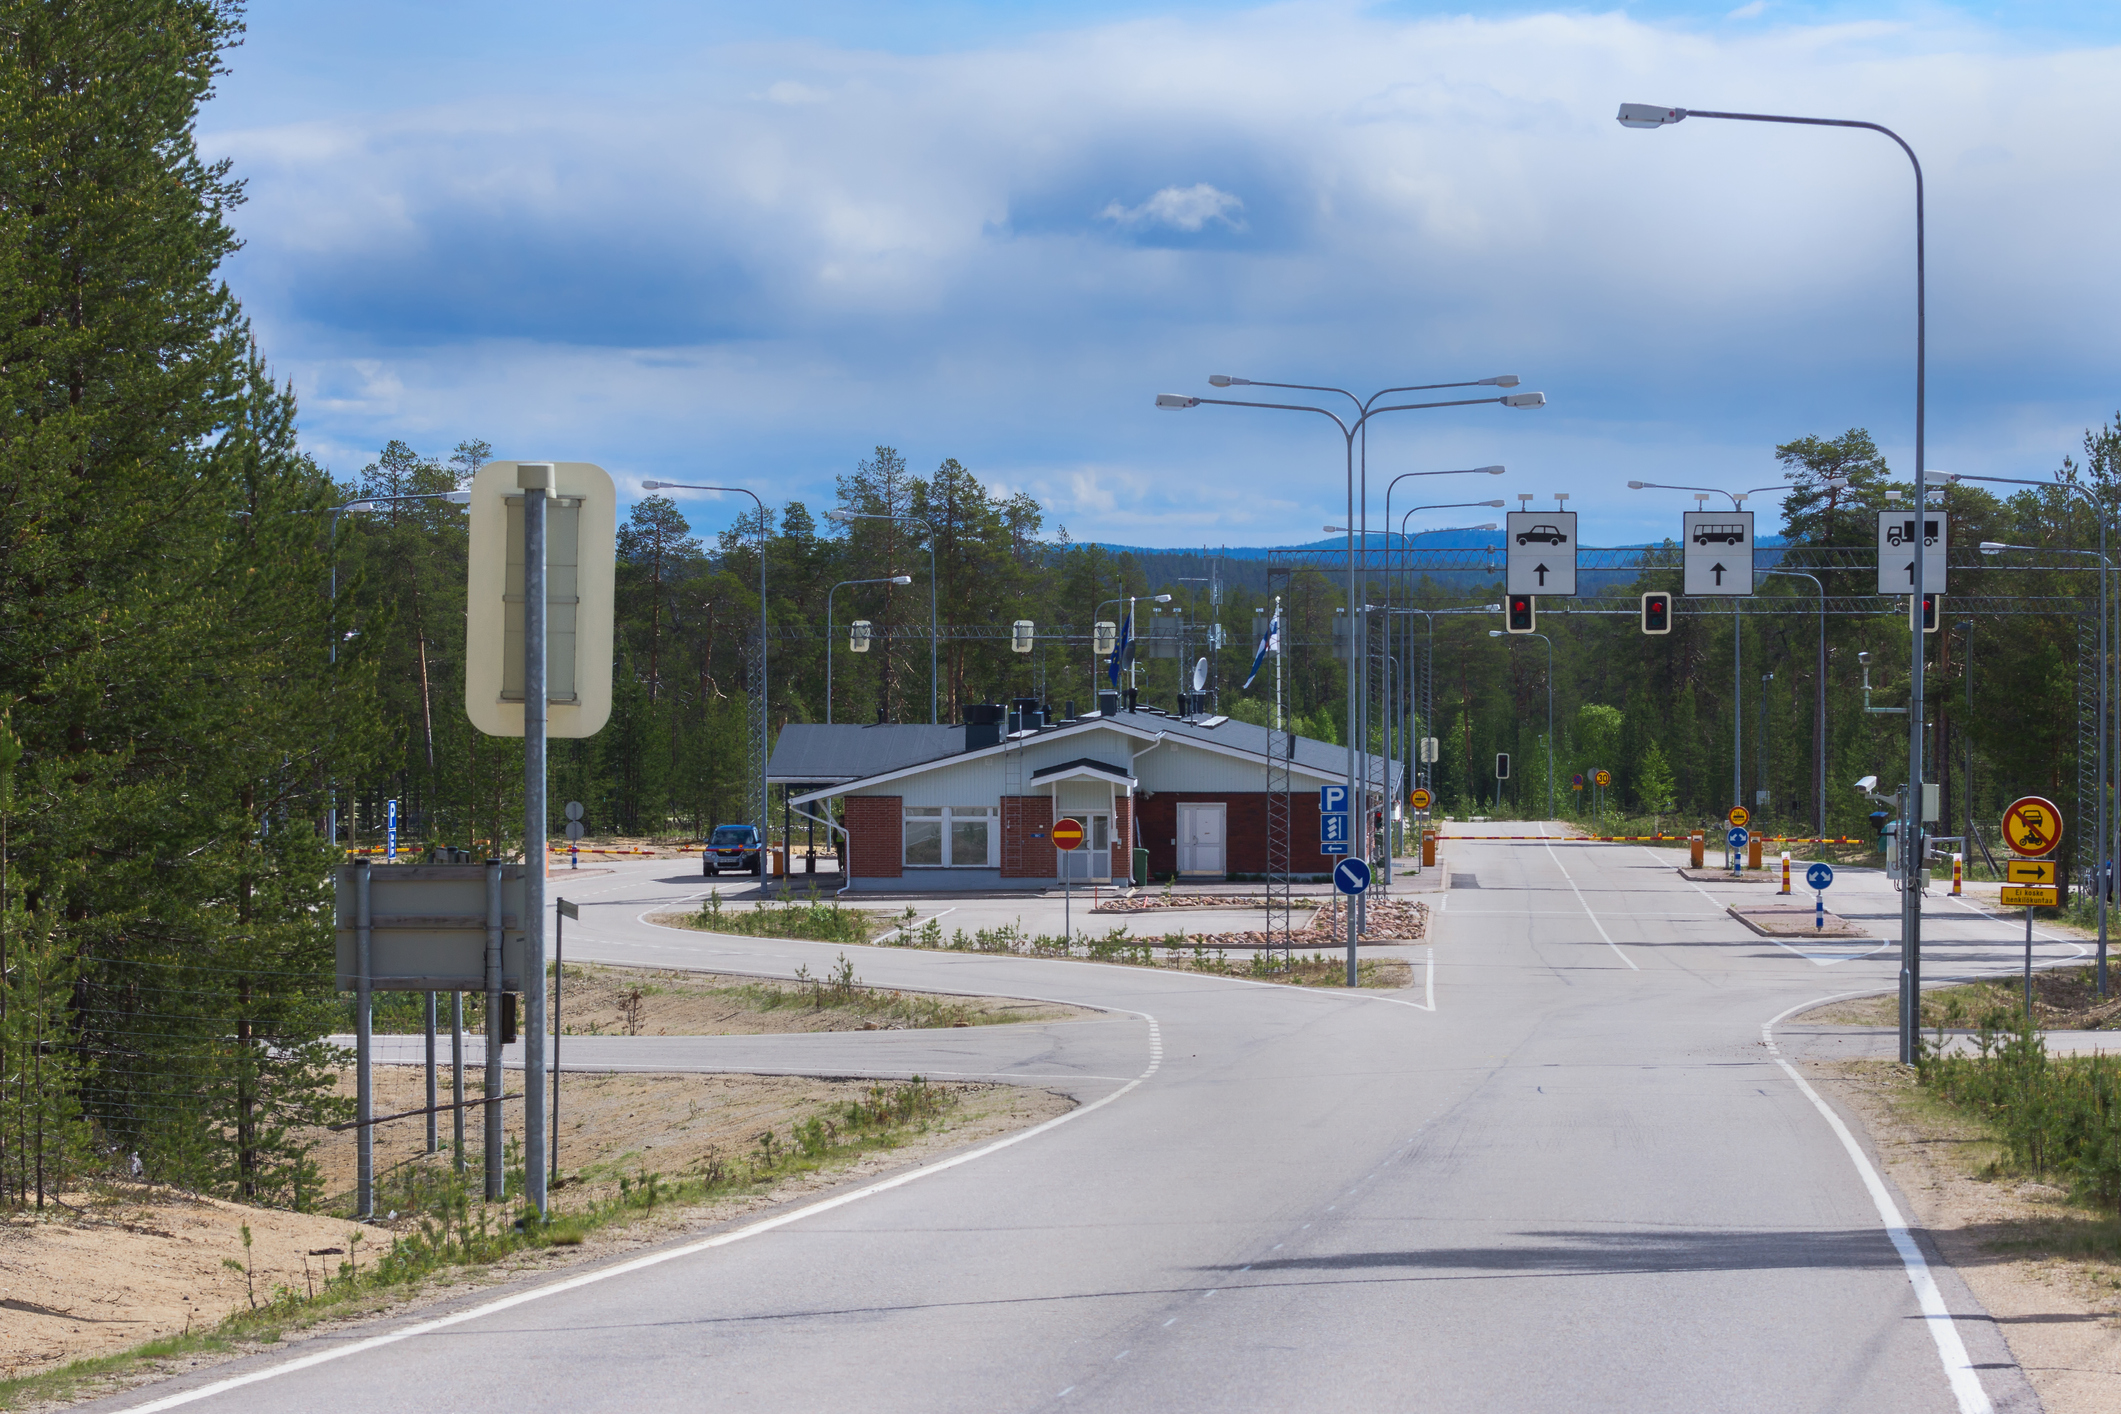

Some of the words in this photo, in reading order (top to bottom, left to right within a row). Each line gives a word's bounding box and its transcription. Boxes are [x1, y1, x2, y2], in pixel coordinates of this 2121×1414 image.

[1598, 774, 1608, 783] 30
[1326, 787, 1345, 811] P
[390, 802, 396, 827] P
[2006, 896, 2053, 904] henkilökuntaa
